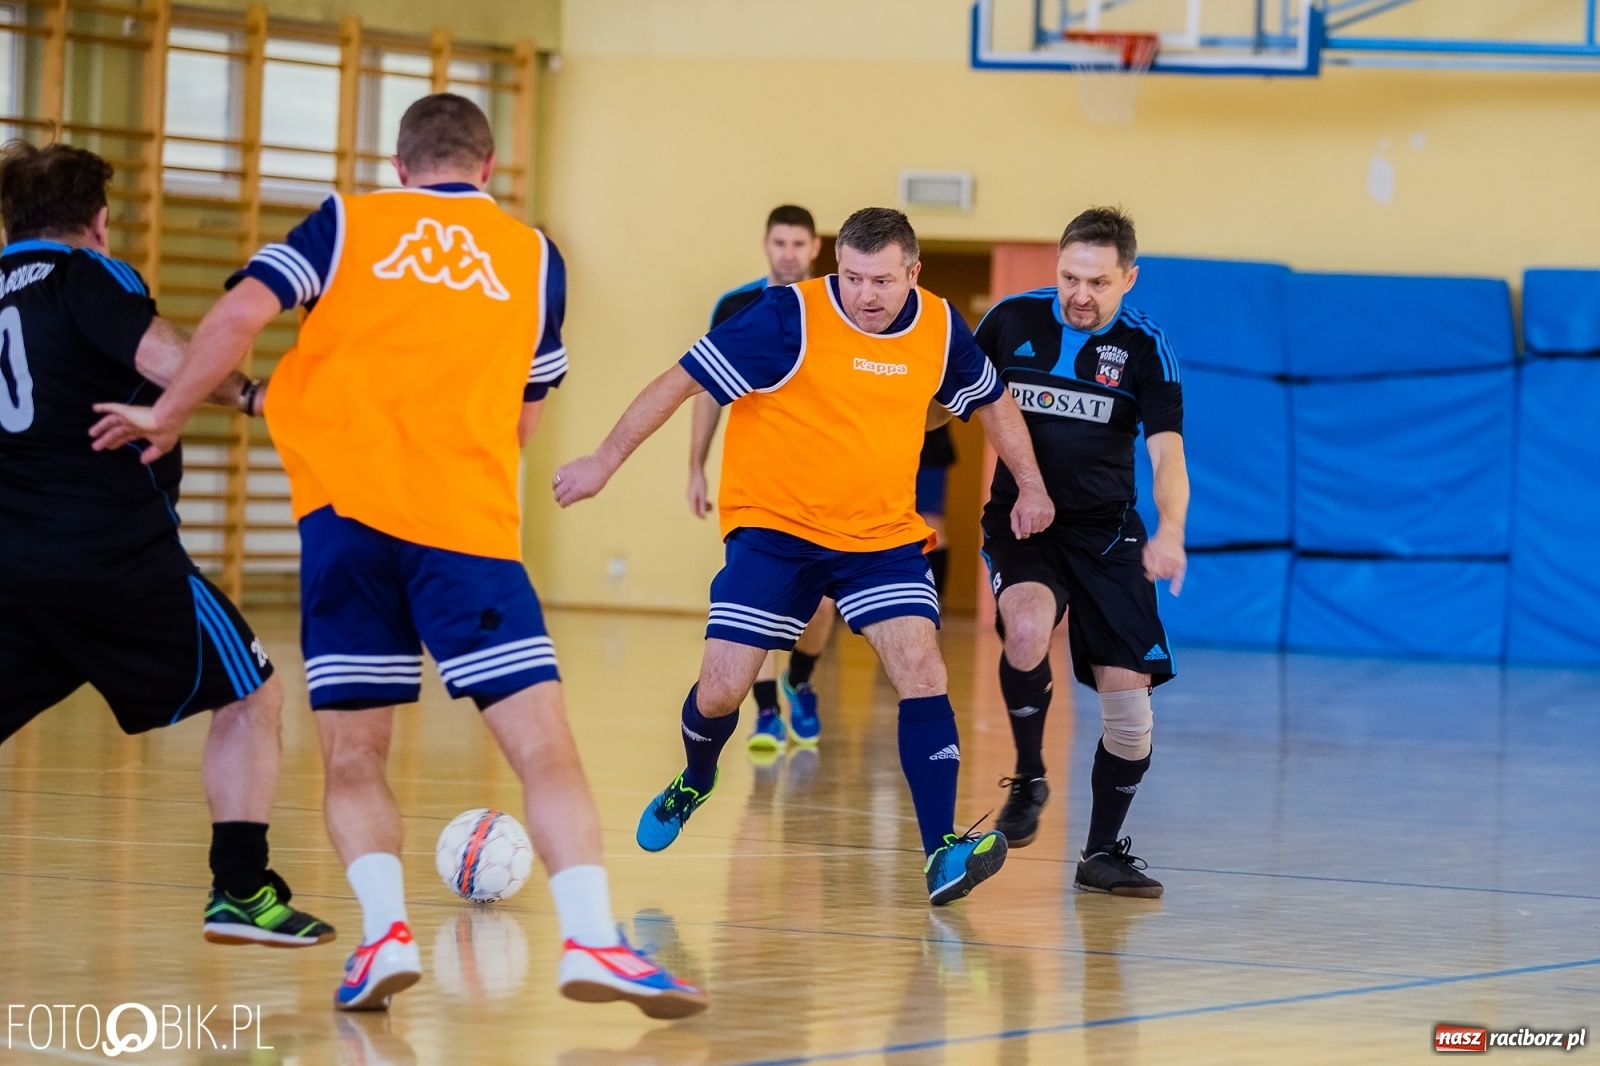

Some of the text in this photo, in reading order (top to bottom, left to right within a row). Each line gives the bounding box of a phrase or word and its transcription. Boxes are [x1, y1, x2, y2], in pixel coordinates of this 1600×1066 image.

[853, 357, 908, 376] Kappa
[1100, 364, 1120, 381] KS
[1010, 388, 1106, 418] PROSAT
